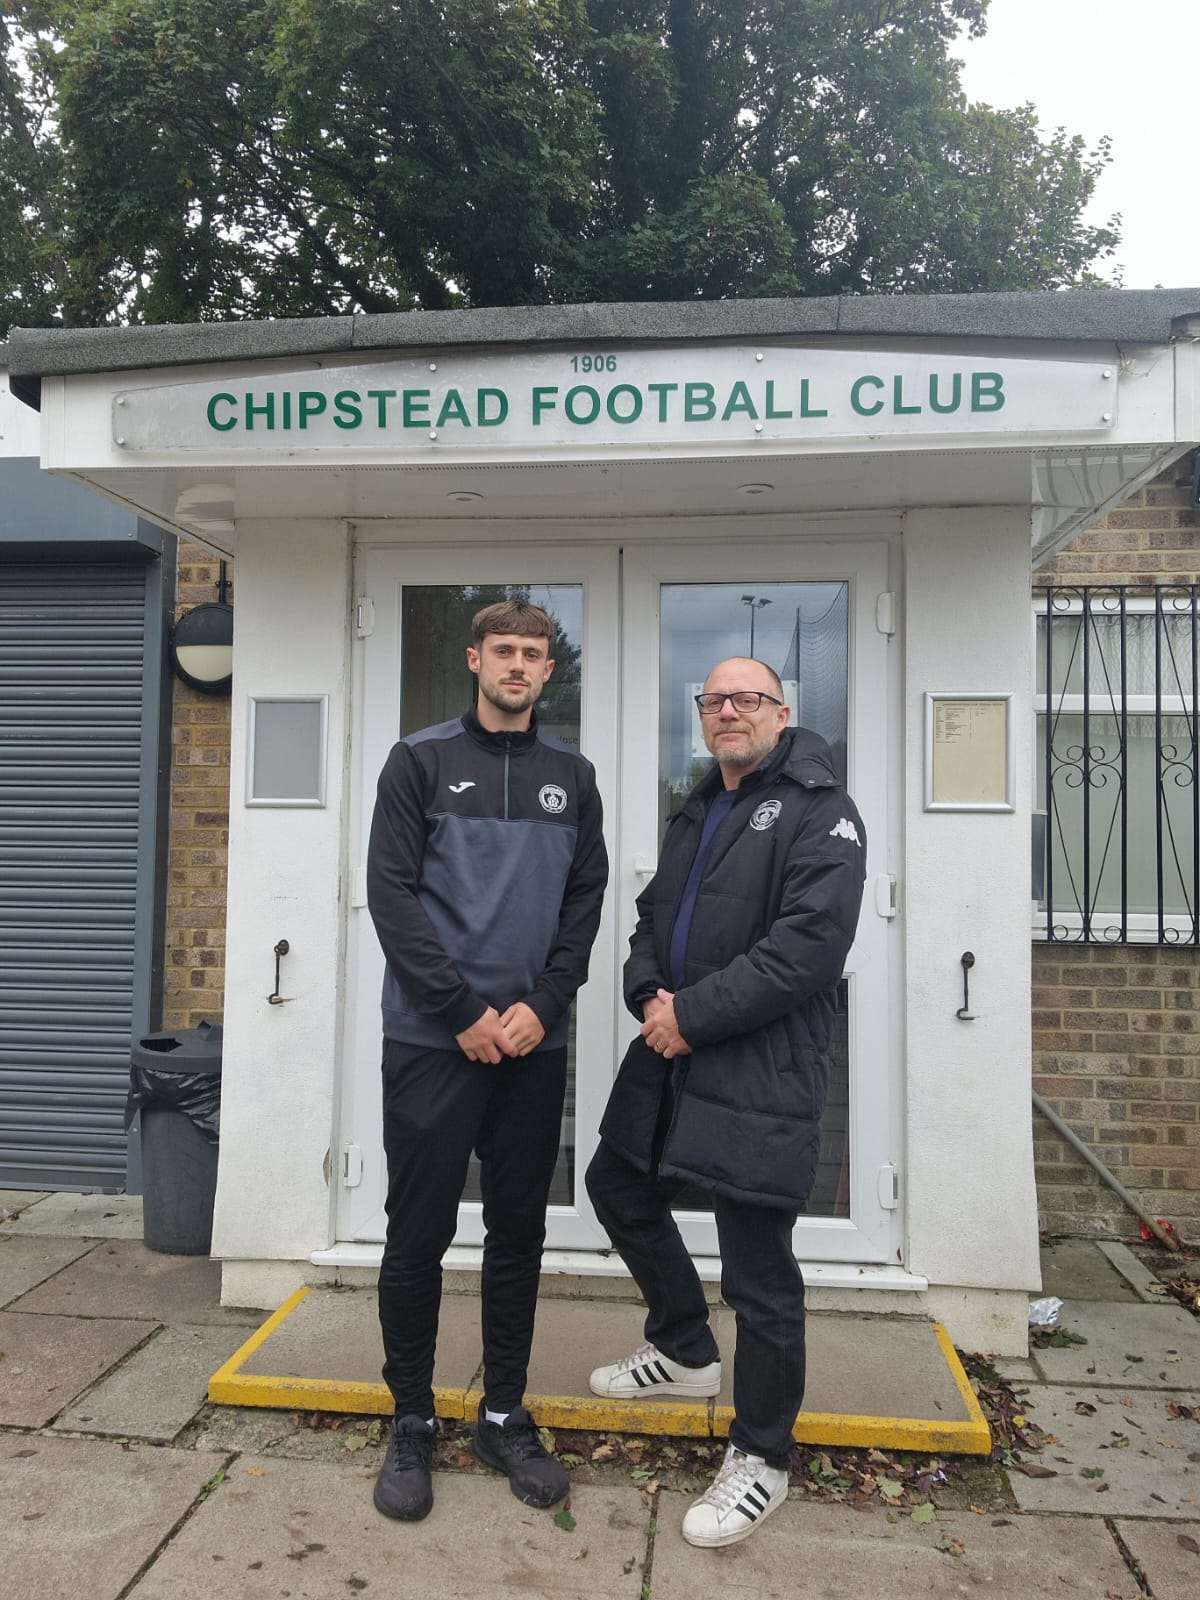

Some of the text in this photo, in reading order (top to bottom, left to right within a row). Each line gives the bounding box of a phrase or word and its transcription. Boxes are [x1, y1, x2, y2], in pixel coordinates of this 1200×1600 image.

[571, 355, 617, 373] 1906
[207, 372, 1005, 431] CHIPSTEAD FOOTBALL CLUB
